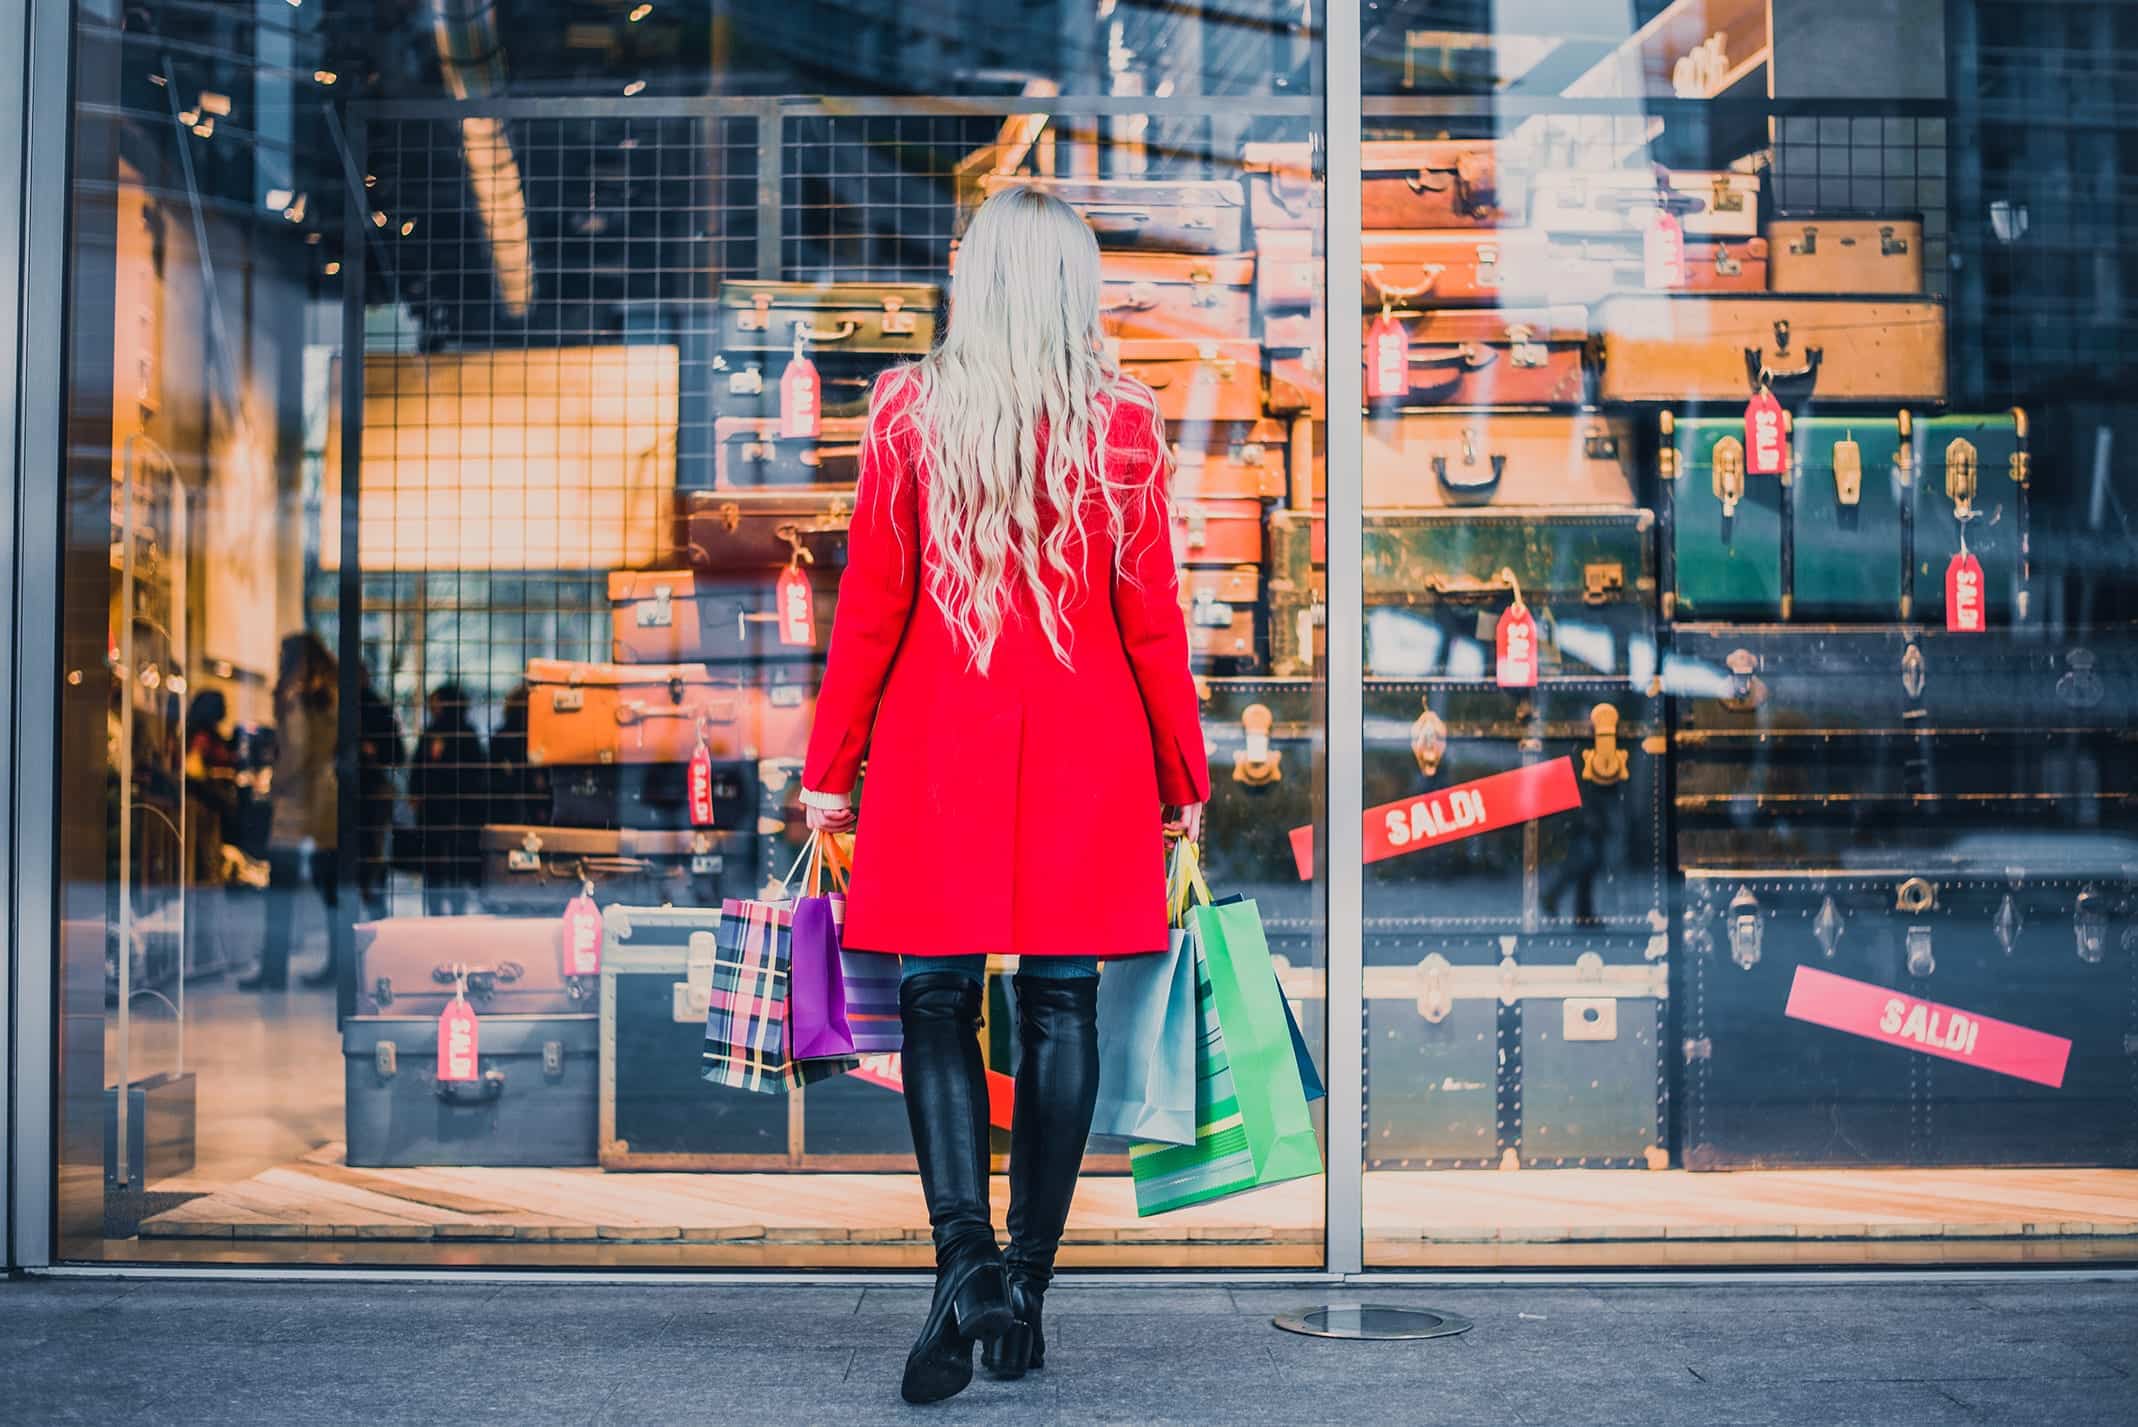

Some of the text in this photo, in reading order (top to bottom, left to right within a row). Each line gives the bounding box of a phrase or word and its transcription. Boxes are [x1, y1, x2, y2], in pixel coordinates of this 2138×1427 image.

[1756, 410, 1778, 470] SALDI
[786, 583, 810, 642] SALDI
[1957, 570, 1979, 629] SALDI
[1507, 624, 1530, 684] SALDI
[694, 764, 709, 821] SALDI
[1385, 789, 1486, 845] SALDI
[573, 914, 595, 974] SALDI
[449, 1019, 471, 1078] SALDI
[1879, 998, 1979, 1056] SALDI
